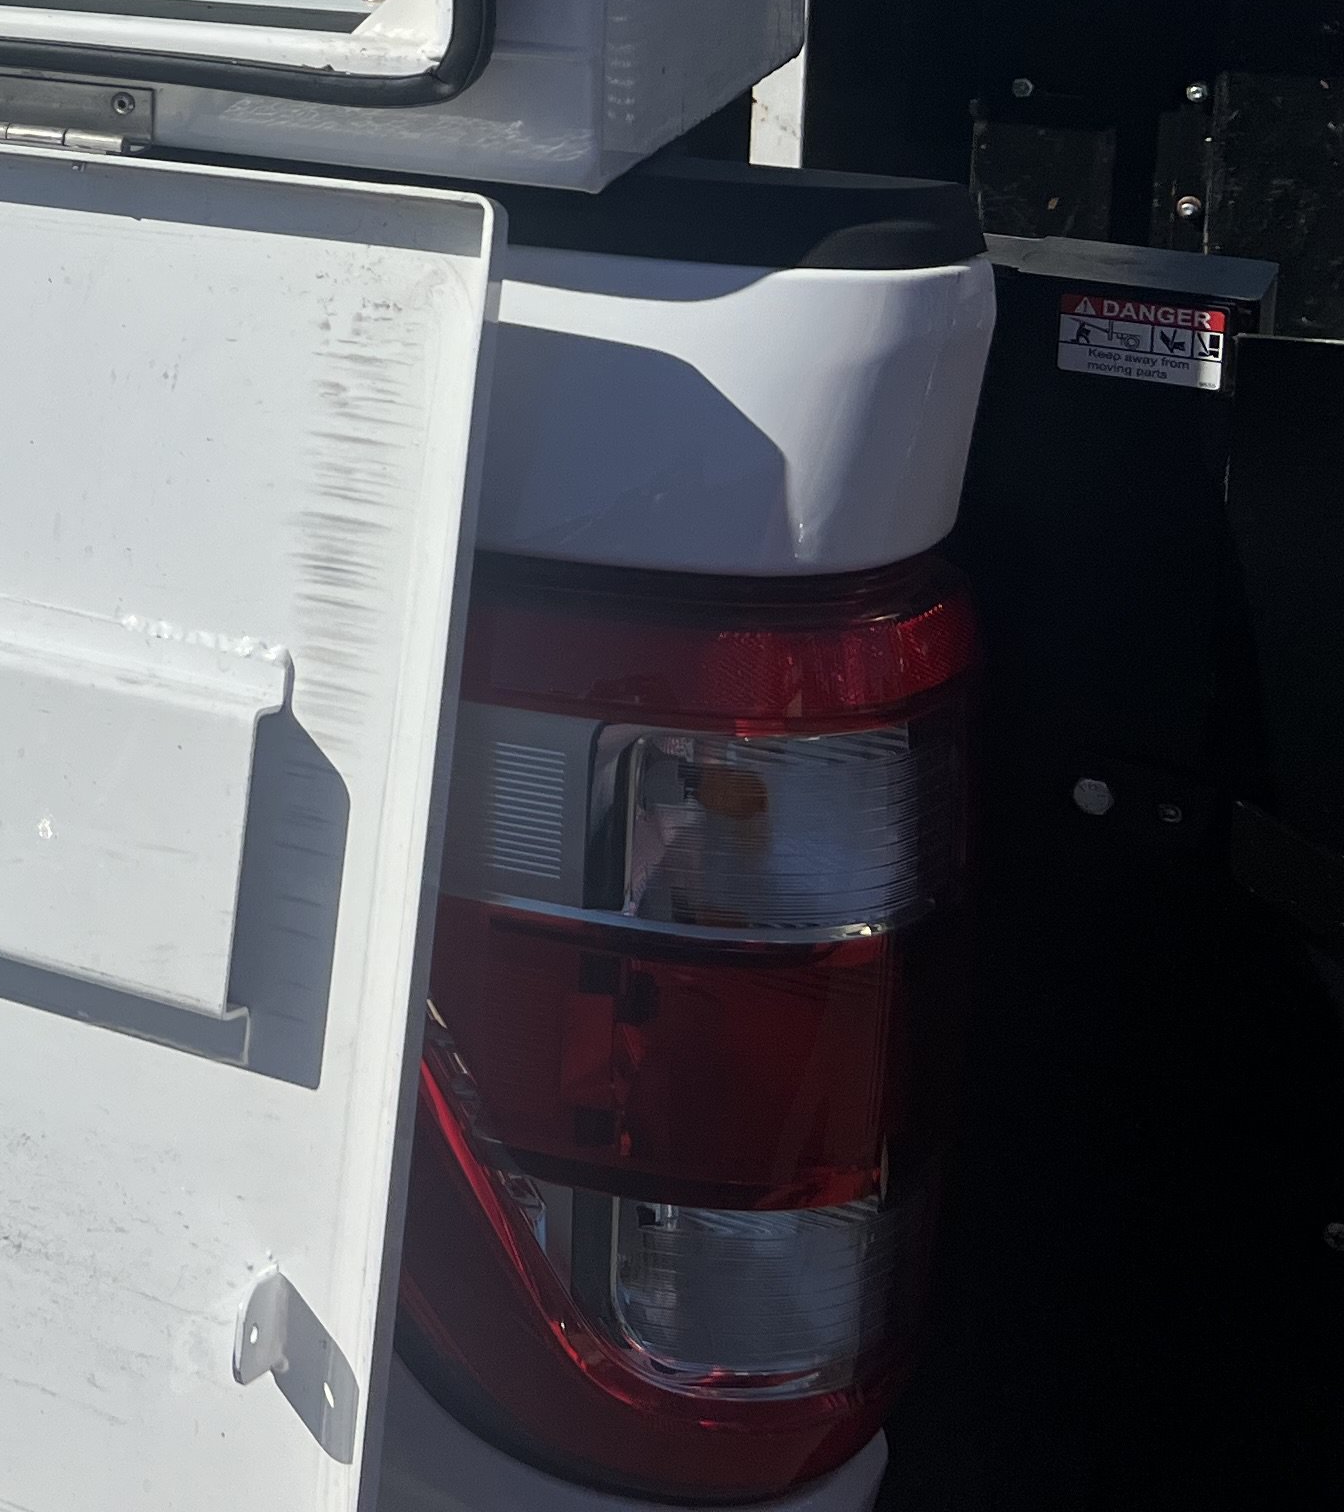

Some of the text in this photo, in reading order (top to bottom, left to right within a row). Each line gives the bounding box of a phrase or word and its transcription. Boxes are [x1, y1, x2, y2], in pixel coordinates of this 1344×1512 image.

[1103, 300, 1212, 329] DANGER
[1088, 348, 1190, 370] Keep away from
[1088, 362, 1168, 379] moving parts
